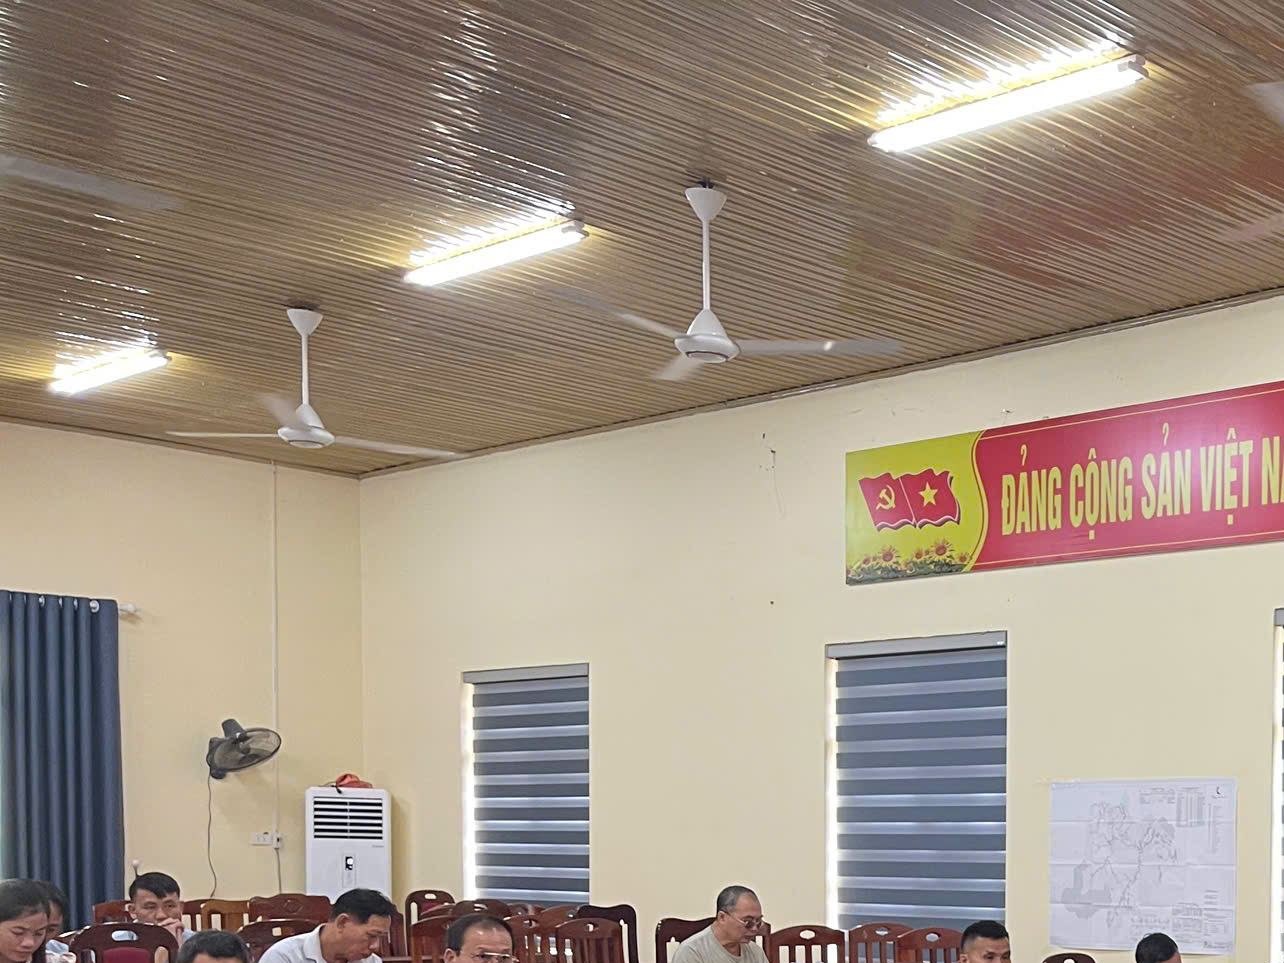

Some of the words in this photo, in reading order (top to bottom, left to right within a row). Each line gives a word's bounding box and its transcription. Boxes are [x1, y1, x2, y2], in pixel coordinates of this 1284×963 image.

[1001, 446, 1062, 536] ĐẢNG
[1069, 447, 1134, 541] CỘNG
[1140, 422, 1192, 519] SẢN
[1200, 434, 1252, 525] VIỆT
